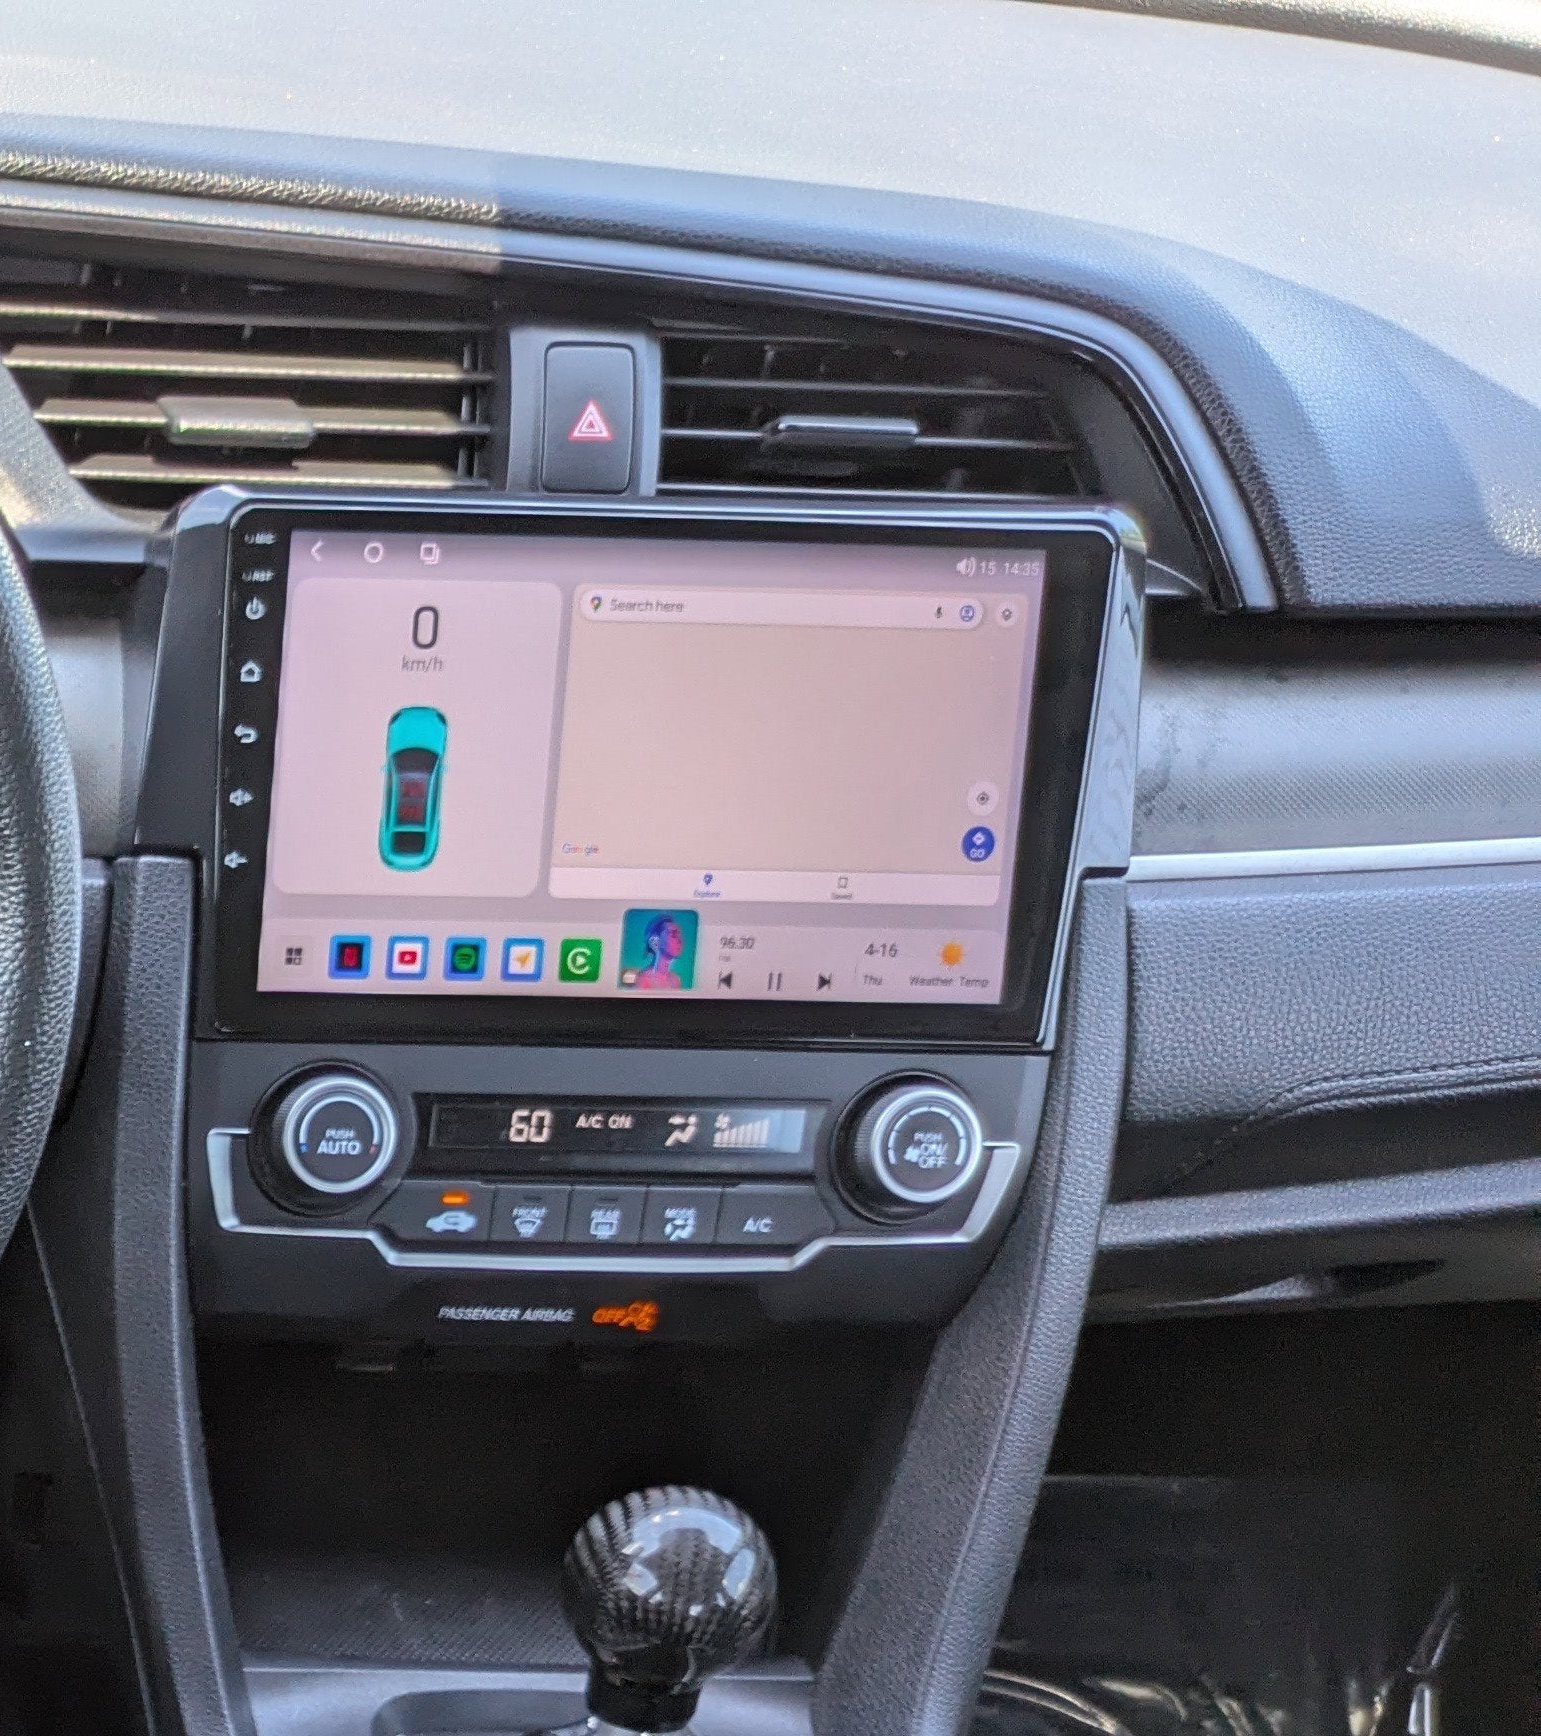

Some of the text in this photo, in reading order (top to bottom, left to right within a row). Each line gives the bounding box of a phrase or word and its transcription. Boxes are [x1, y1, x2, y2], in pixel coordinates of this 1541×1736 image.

[980, 560, 1040, 577] 15 14:35
[609, 597, 685, 614] Search here
[412, 606, 439, 650] 0
[401, 655, 444, 672] km/h
[561, 842, 600, 857] Google
[864, 943, 898, 958] 4-16
[862, 974, 884, 987] Thu
[909, 975, 990, 990] Weather Temp
[508, 1108, 555, 1143] 60
[574, 1114, 633, 1130] A/C ON
[317, 1140, 363, 1156] AUTO
[742, 1216, 773, 1234] A/C
[437, 1305, 520, 1322] PASSENGER
[520, 1307, 577, 1323] AIRBAG
